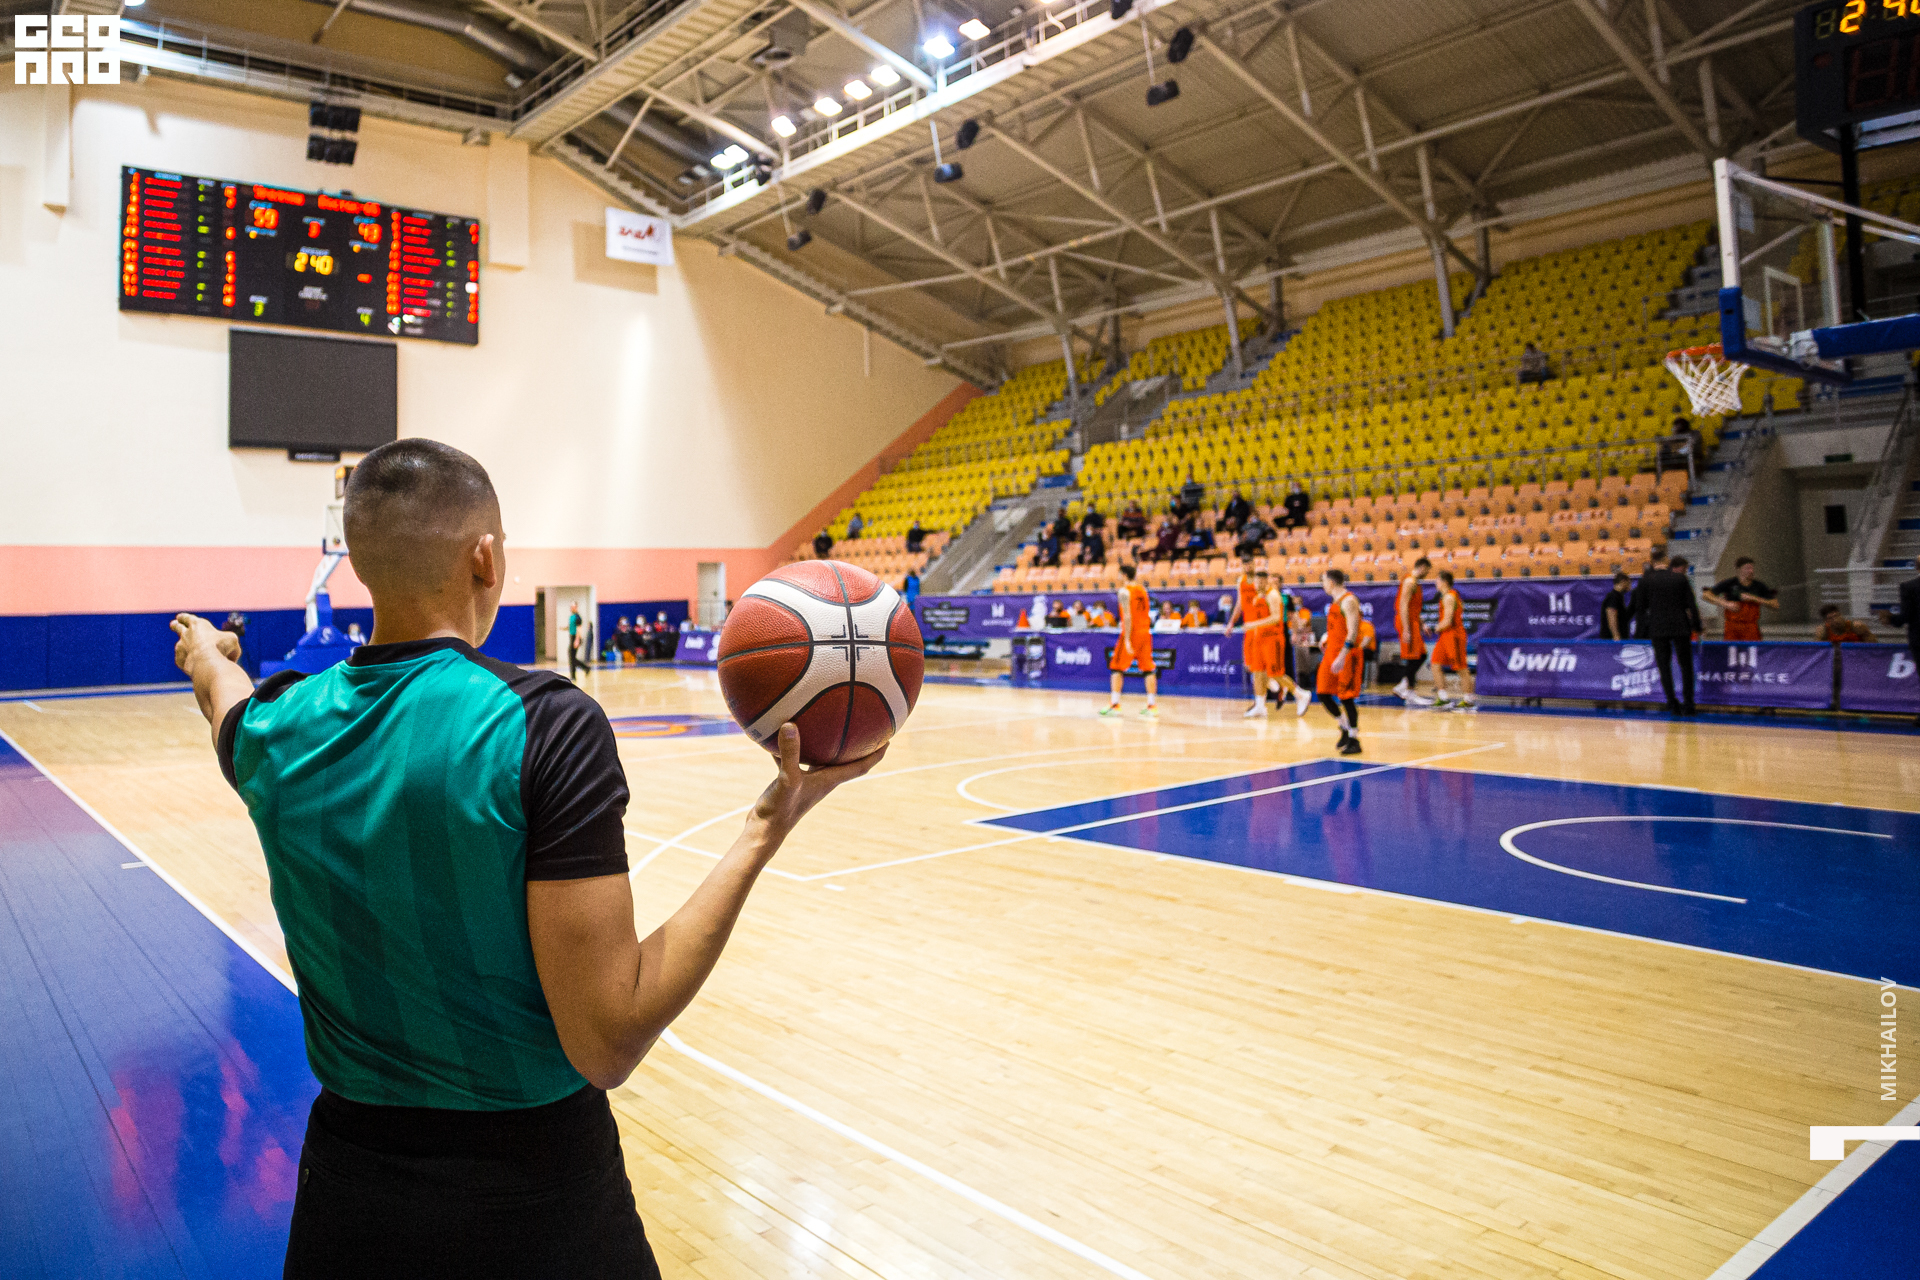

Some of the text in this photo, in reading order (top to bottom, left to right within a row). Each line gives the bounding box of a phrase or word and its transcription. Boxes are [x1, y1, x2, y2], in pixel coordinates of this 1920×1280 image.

[1528, 614, 1594, 626] WARFACE
[1507, 647, 1578, 672] bwin
[1697, 671, 1789, 684] WARFACE
